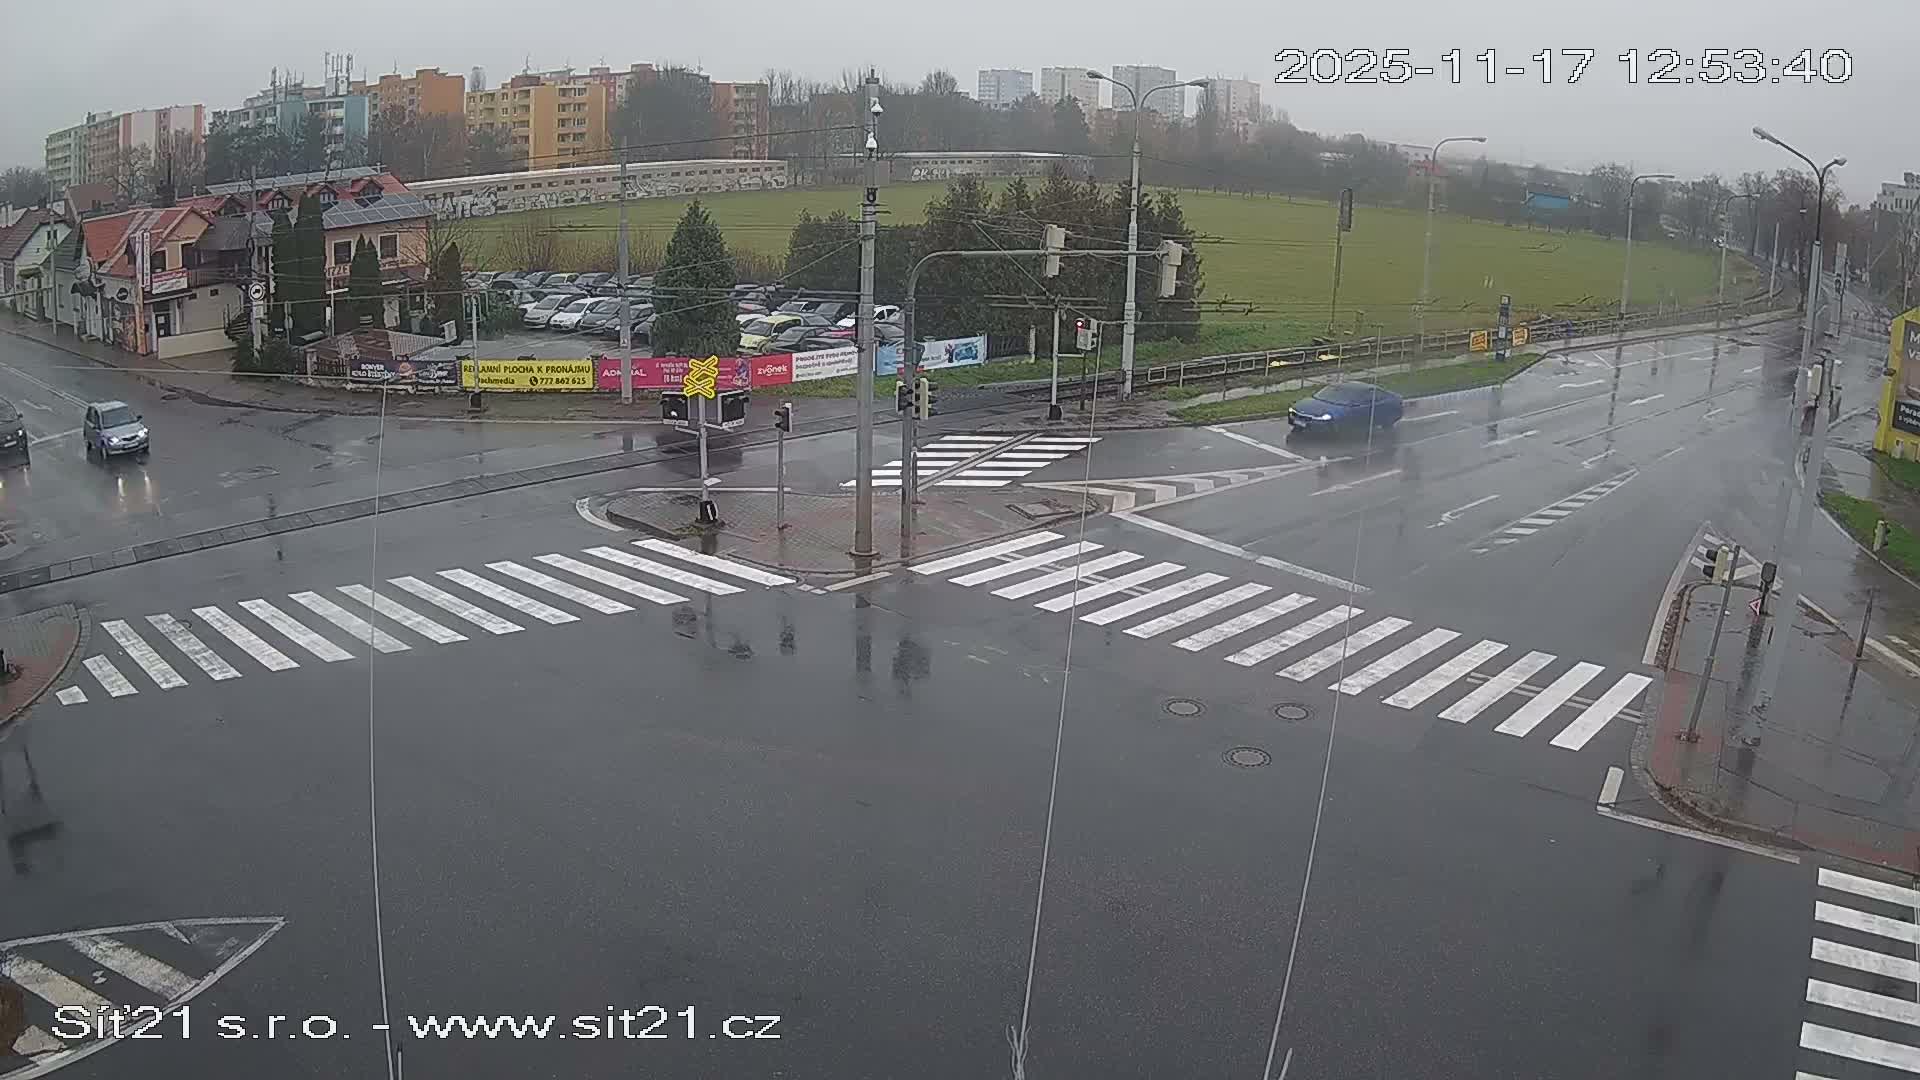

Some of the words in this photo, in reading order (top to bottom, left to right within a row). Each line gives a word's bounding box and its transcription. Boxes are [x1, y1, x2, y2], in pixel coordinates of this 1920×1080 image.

[503, 365, 534, 374] PLOCHA
[536, 365, 543, 374] K
[545, 363, 591, 374] PRONÁJMU
[602, 368, 648, 378] ADMAL
[539, 377, 553, 385] 777
